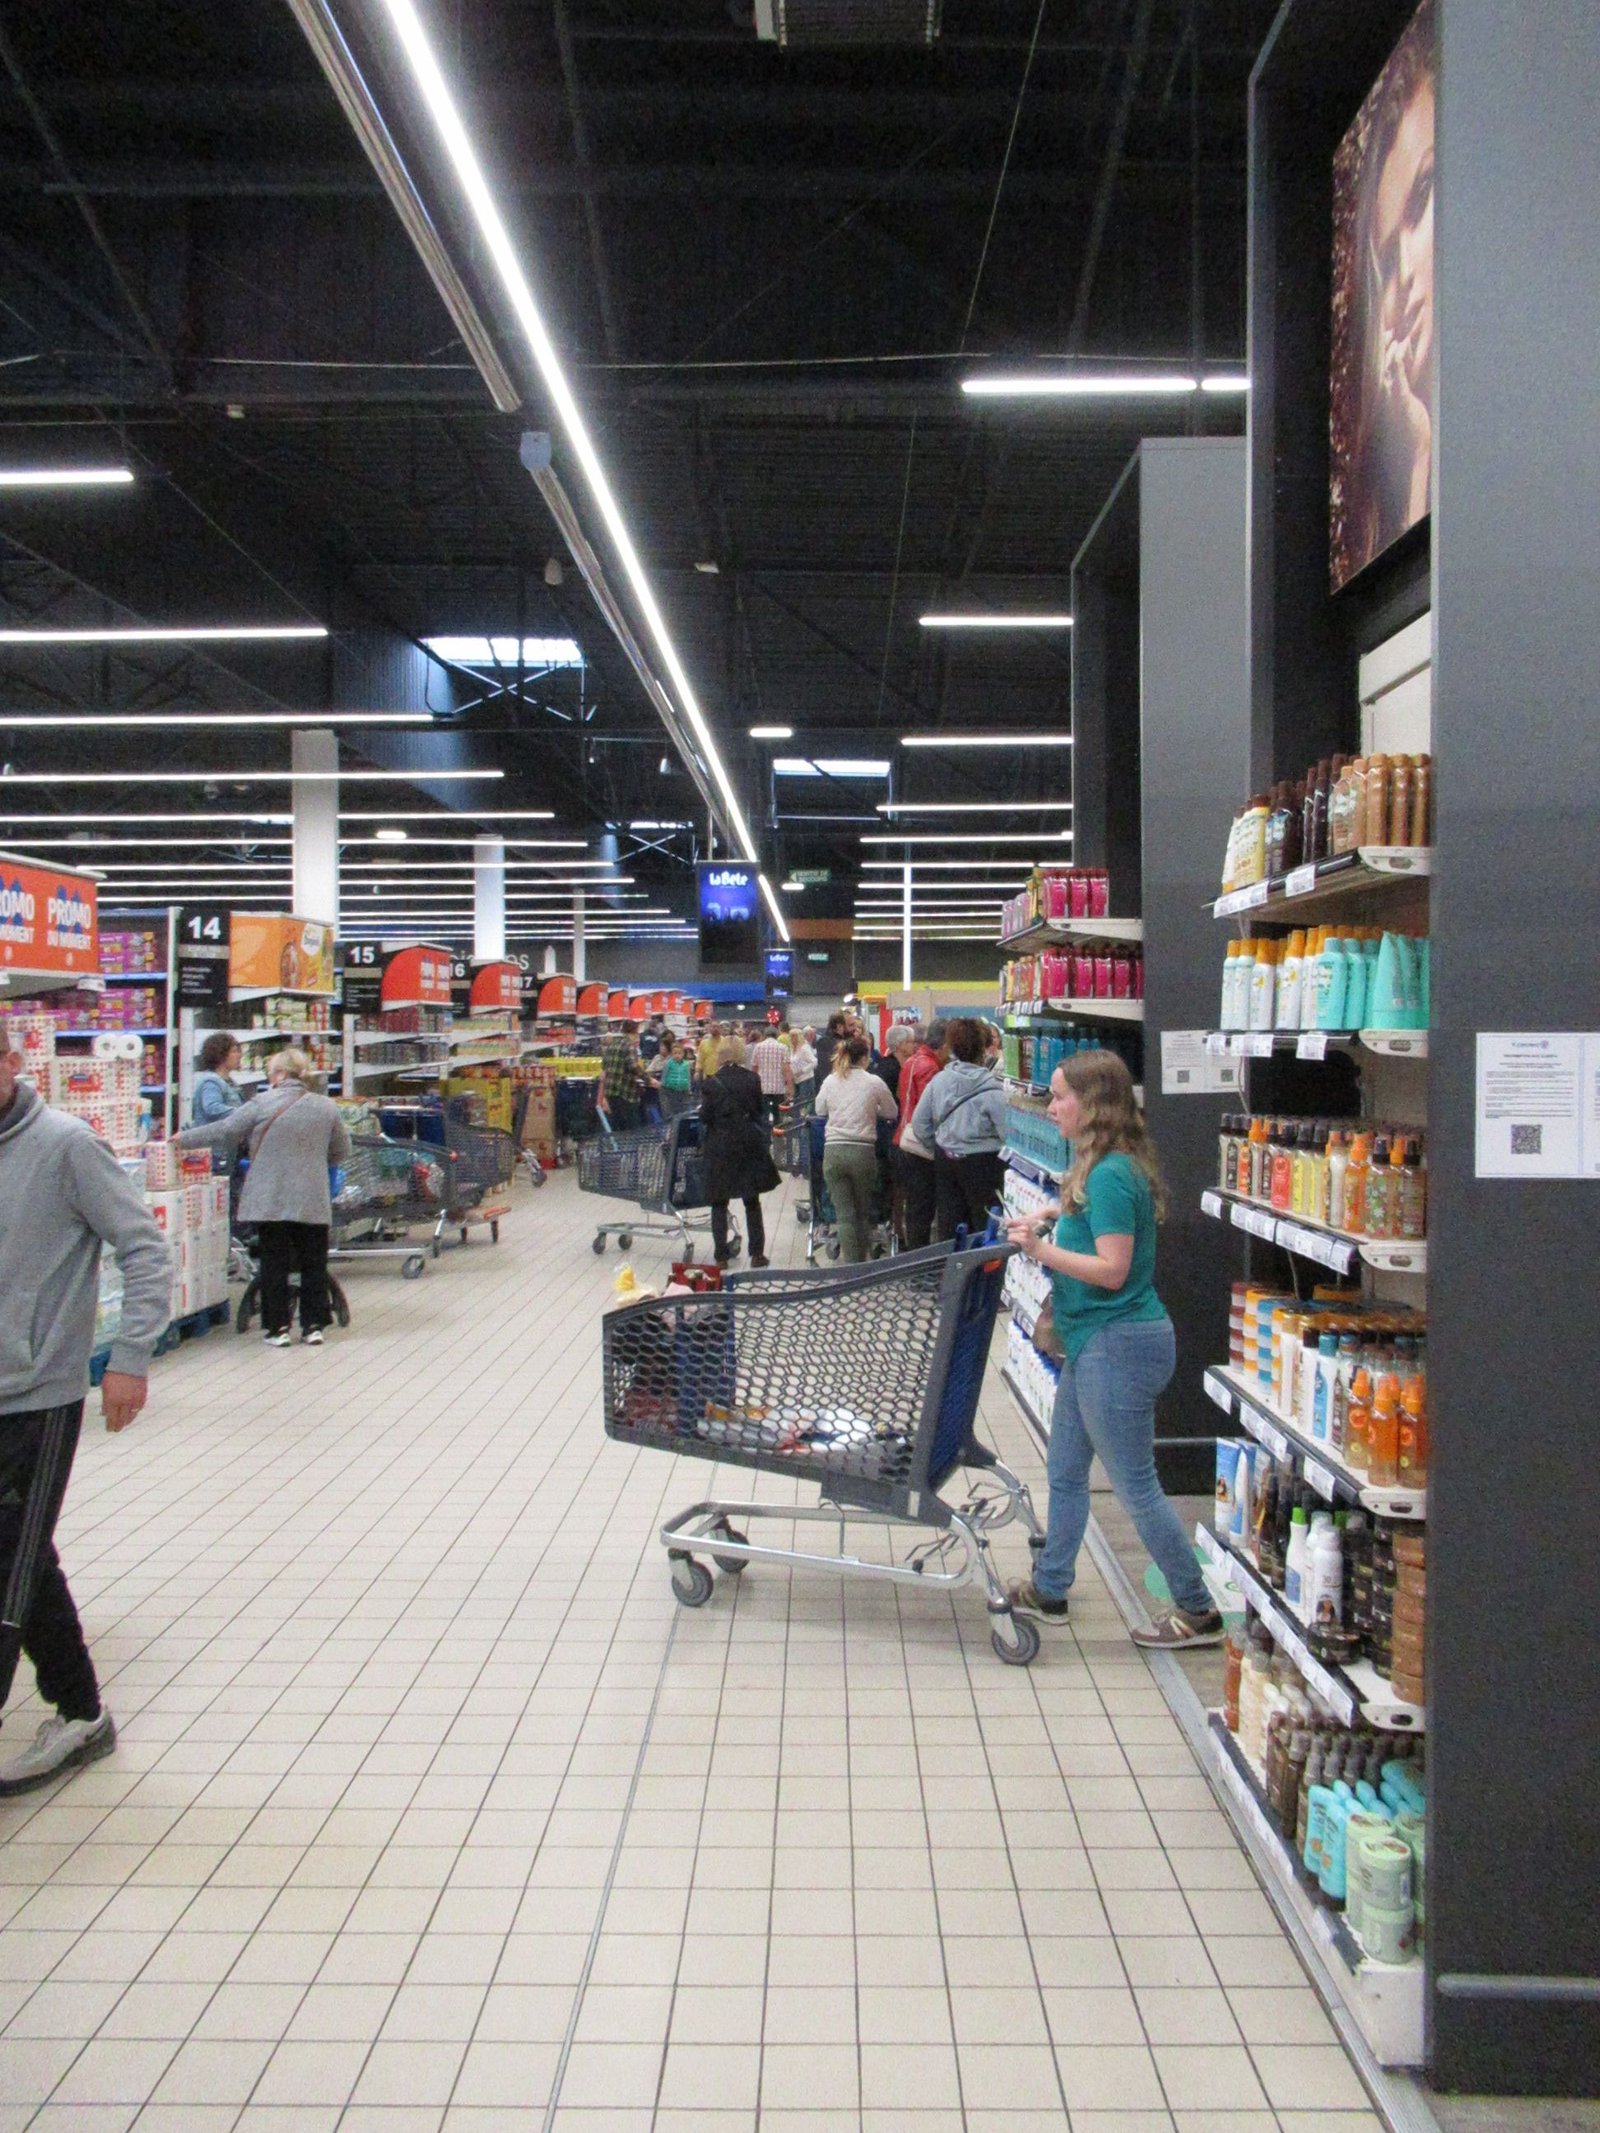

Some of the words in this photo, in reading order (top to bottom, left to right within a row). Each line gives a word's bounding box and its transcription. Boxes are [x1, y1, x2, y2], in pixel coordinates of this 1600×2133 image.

[47, 897, 92, 930] PROMO
[188, 916, 221, 939] 14
[59, 931, 92, 950] MOMENT
[351, 946, 375, 964] 15
